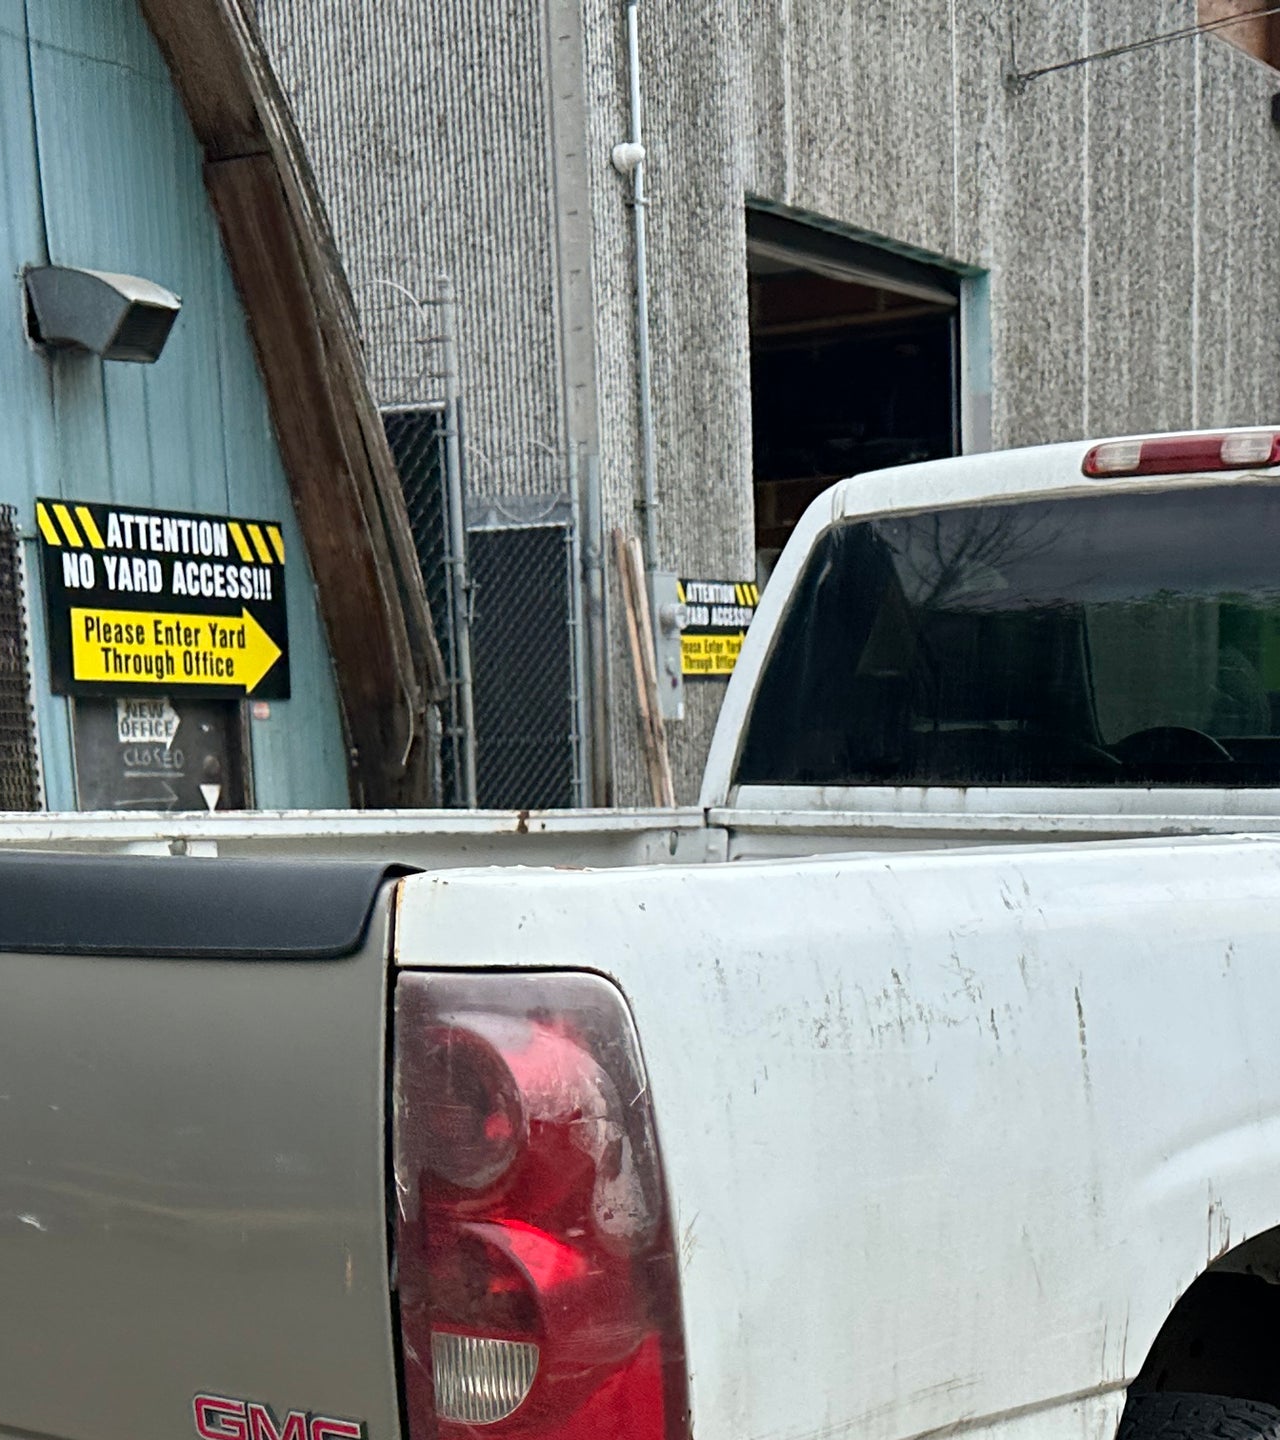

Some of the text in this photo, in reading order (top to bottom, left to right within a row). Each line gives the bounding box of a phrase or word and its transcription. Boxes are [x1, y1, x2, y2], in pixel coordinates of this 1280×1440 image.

[107, 512, 229, 557] ATTENTION
[62, 552, 272, 600] NO YARD ACCESS!!!
[686, 582, 736, 603] ATTENTION
[84, 616, 246, 649] Please Enter Yard
[101, 647, 234, 679] Through Office
[125, 701, 165, 718] NEW
[121, 718, 173, 738] OFFICE
